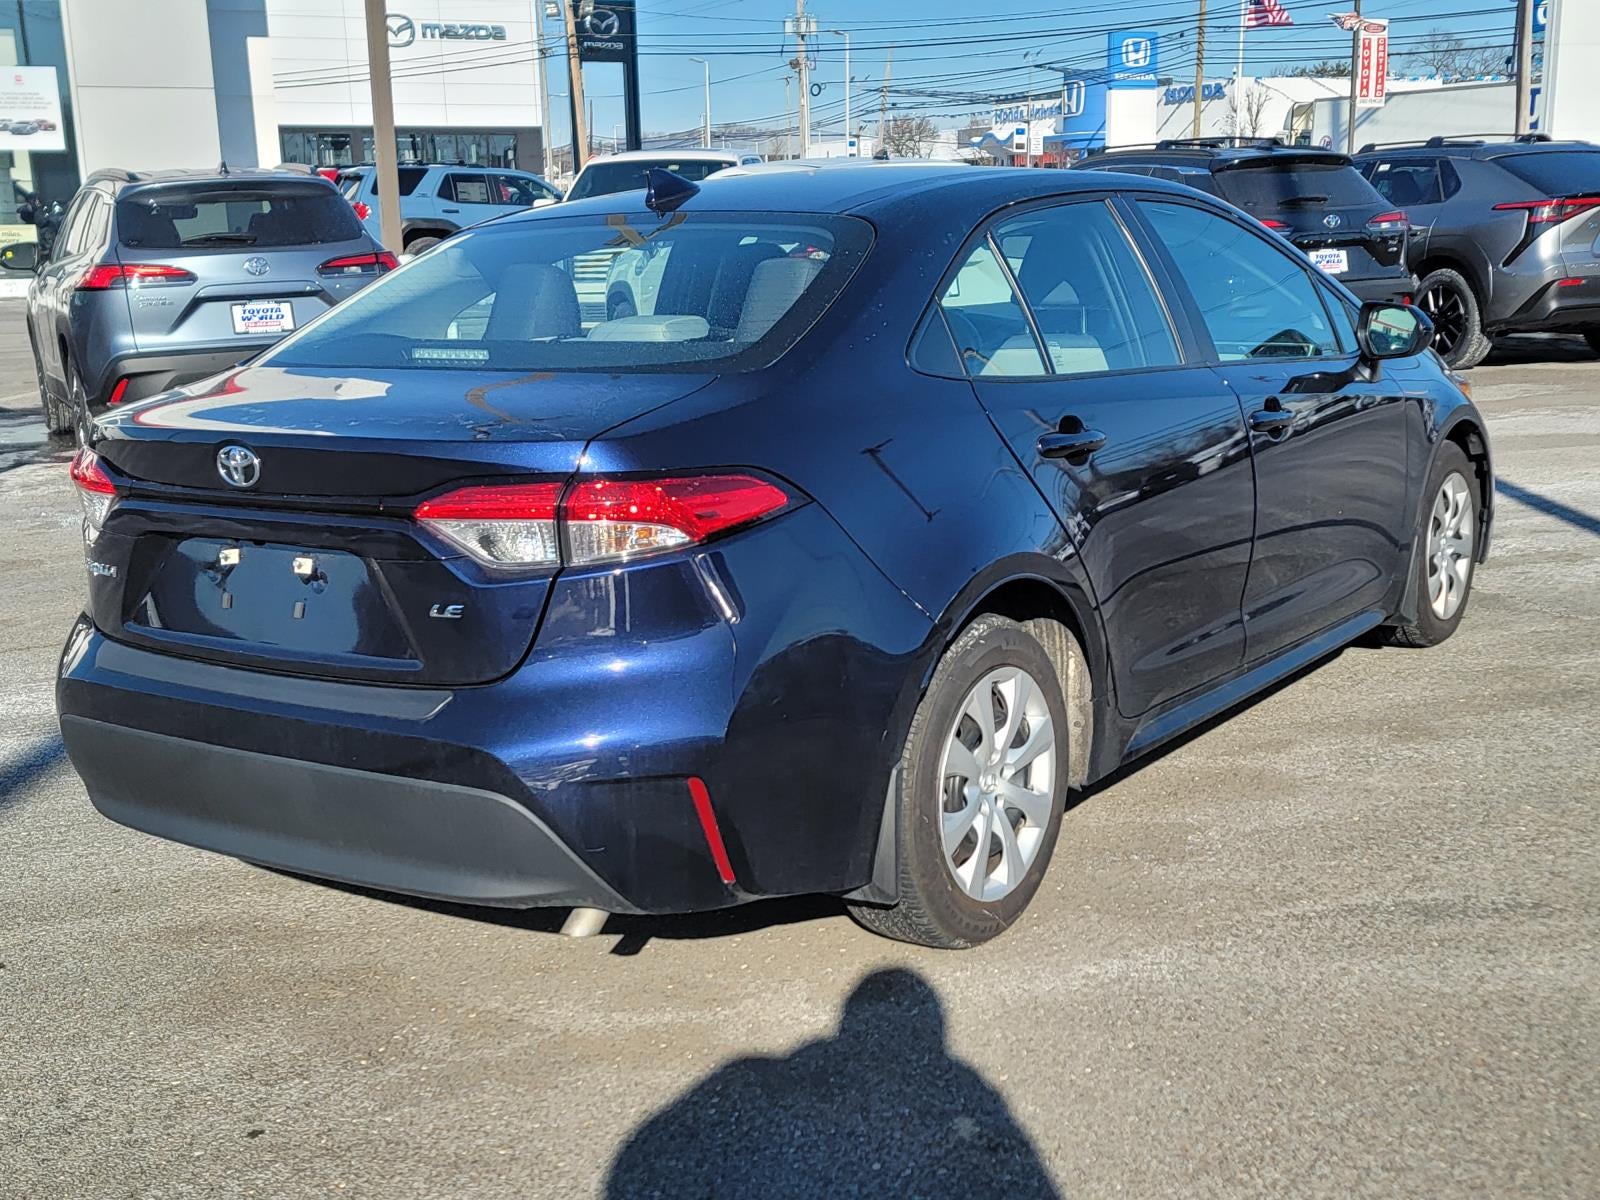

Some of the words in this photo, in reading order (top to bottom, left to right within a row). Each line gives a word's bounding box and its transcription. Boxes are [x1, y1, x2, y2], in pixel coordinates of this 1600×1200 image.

[1361, 39, 1371, 97] TOYOTA
[1375, 38, 1386, 97] CERTIFIED
[242, 307, 281, 315] TOYOTA
[430, 604, 464, 618] LE
